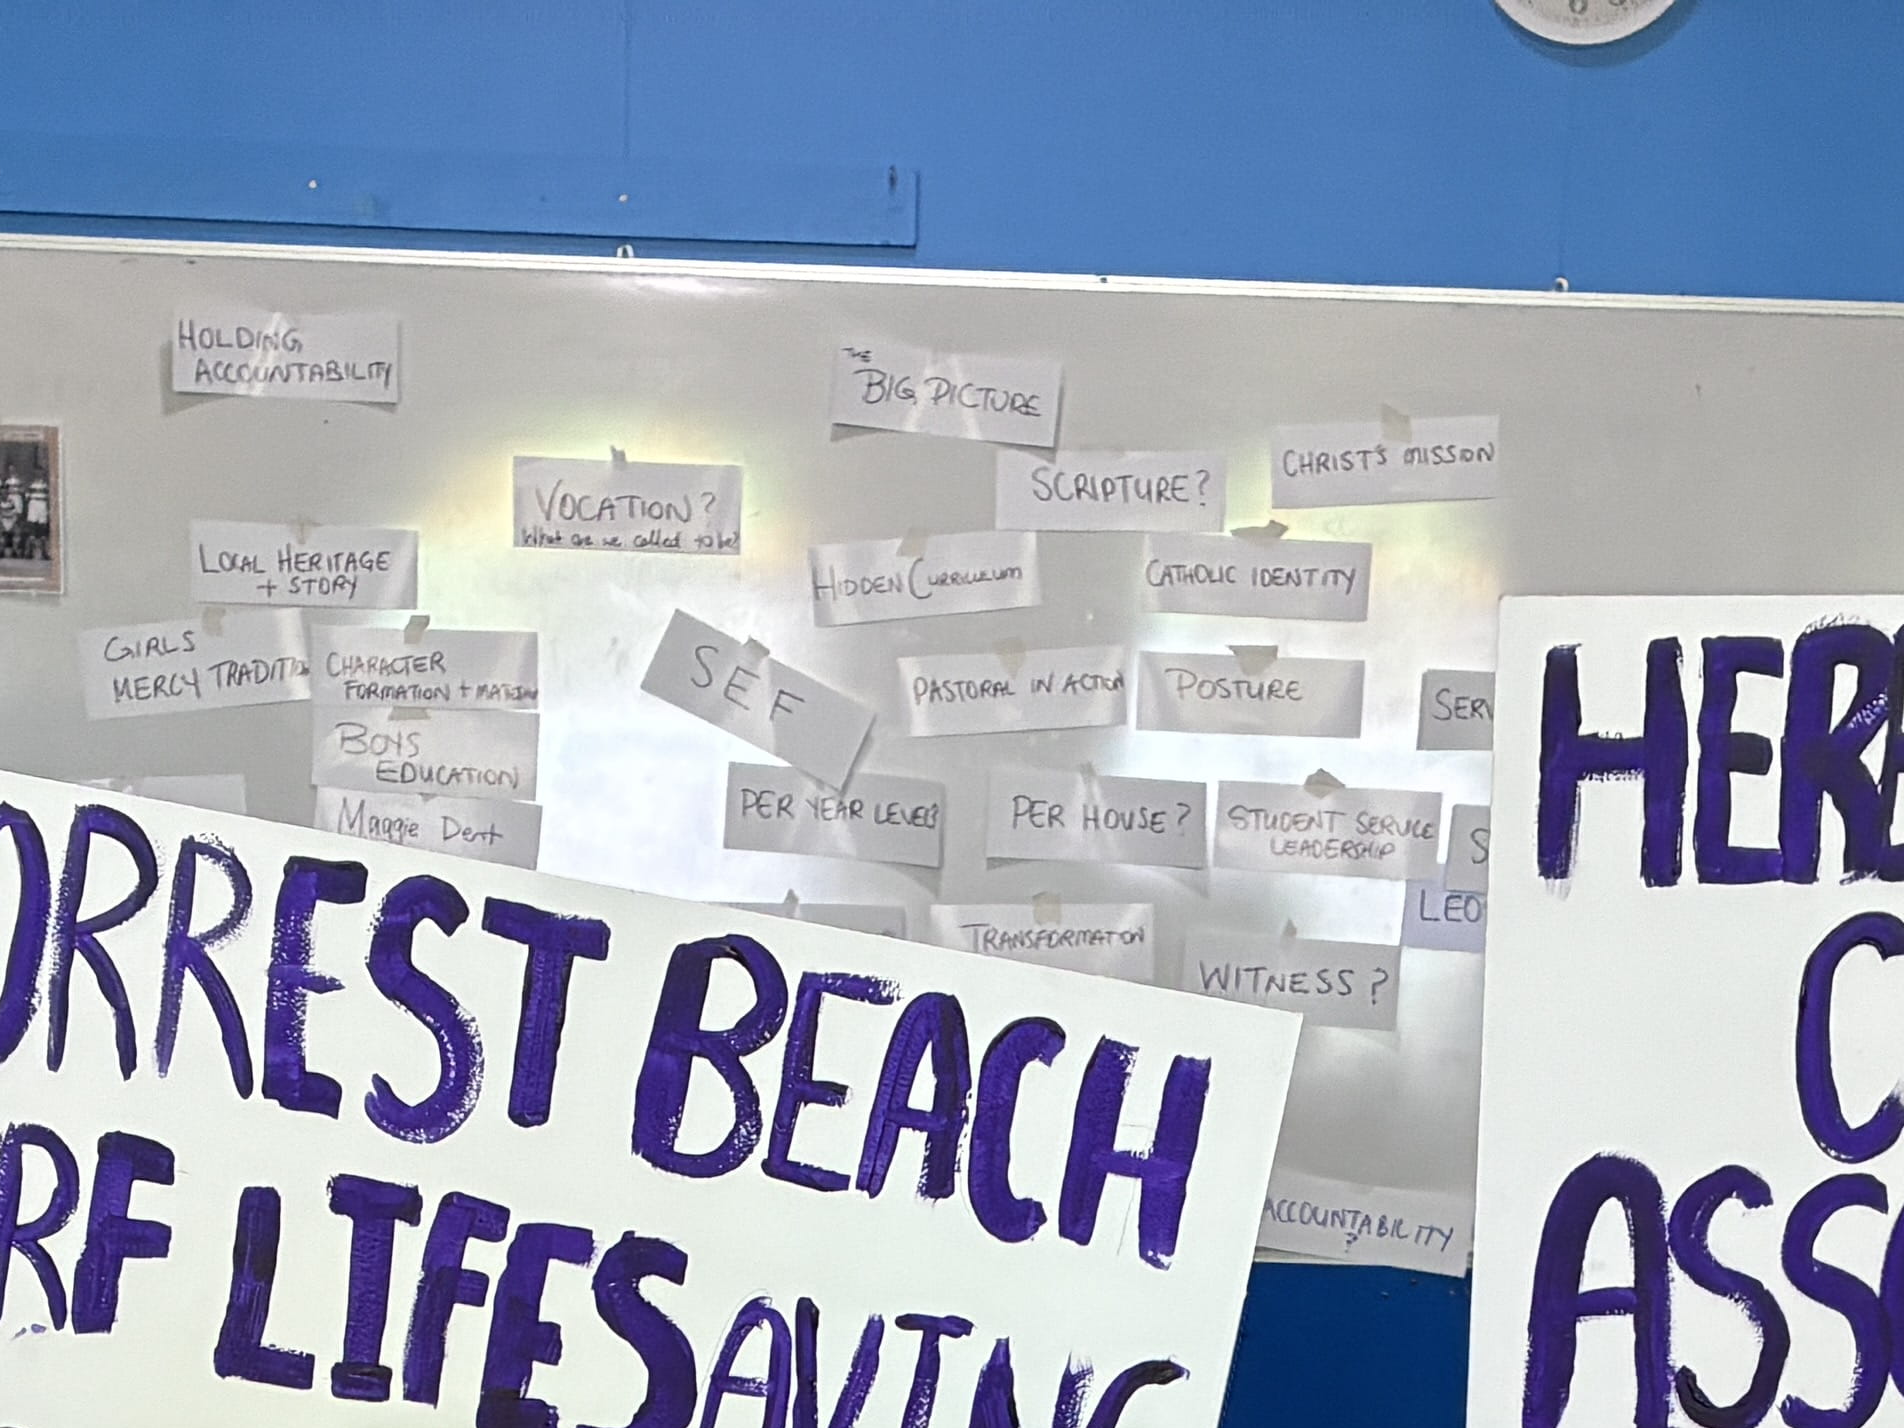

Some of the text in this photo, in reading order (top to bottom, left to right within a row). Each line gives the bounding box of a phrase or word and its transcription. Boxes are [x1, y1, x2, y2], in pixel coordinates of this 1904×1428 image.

[178, 318, 303, 353] HOLDING
[195, 357, 392, 390] ACCOUNTABILITY
[853, 368, 1041, 417] BIG PICTURE
[1282, 443, 1388, 478] CHRIST'S
[199, 544, 391, 575] LOCAL HERITAGE
[1145, 559, 1356, 590] CATHOLIC IDENTITY
[288, 576, 357, 597] STORY
[811, 563, 903, 601] HIDDEN
[104, 631, 195, 662] GIRLS
[326, 651, 446, 677] CHARACTER
[113, 670, 200, 704] MERCY
[345, 680, 450, 701] FORMATION
[913, 676, 1016, 705] PASTORAL
[1031, 672, 1054, 694] IN
[1166, 668, 1303, 702] POSTURE
[376, 760, 519, 789] EDUCATION
[741, 789, 795, 820] PER
[805, 797, 864, 821] YEAR
[1012, 795, 1066, 829] PER
[1227, 805, 1435, 840] STUDENT SERVICE
[1270, 838, 1397, 860] LEADERSHIP
[632, 935, 1212, 1267] BEACH
[1264, 1197, 1454, 1252] ACCOUNTABILITY
